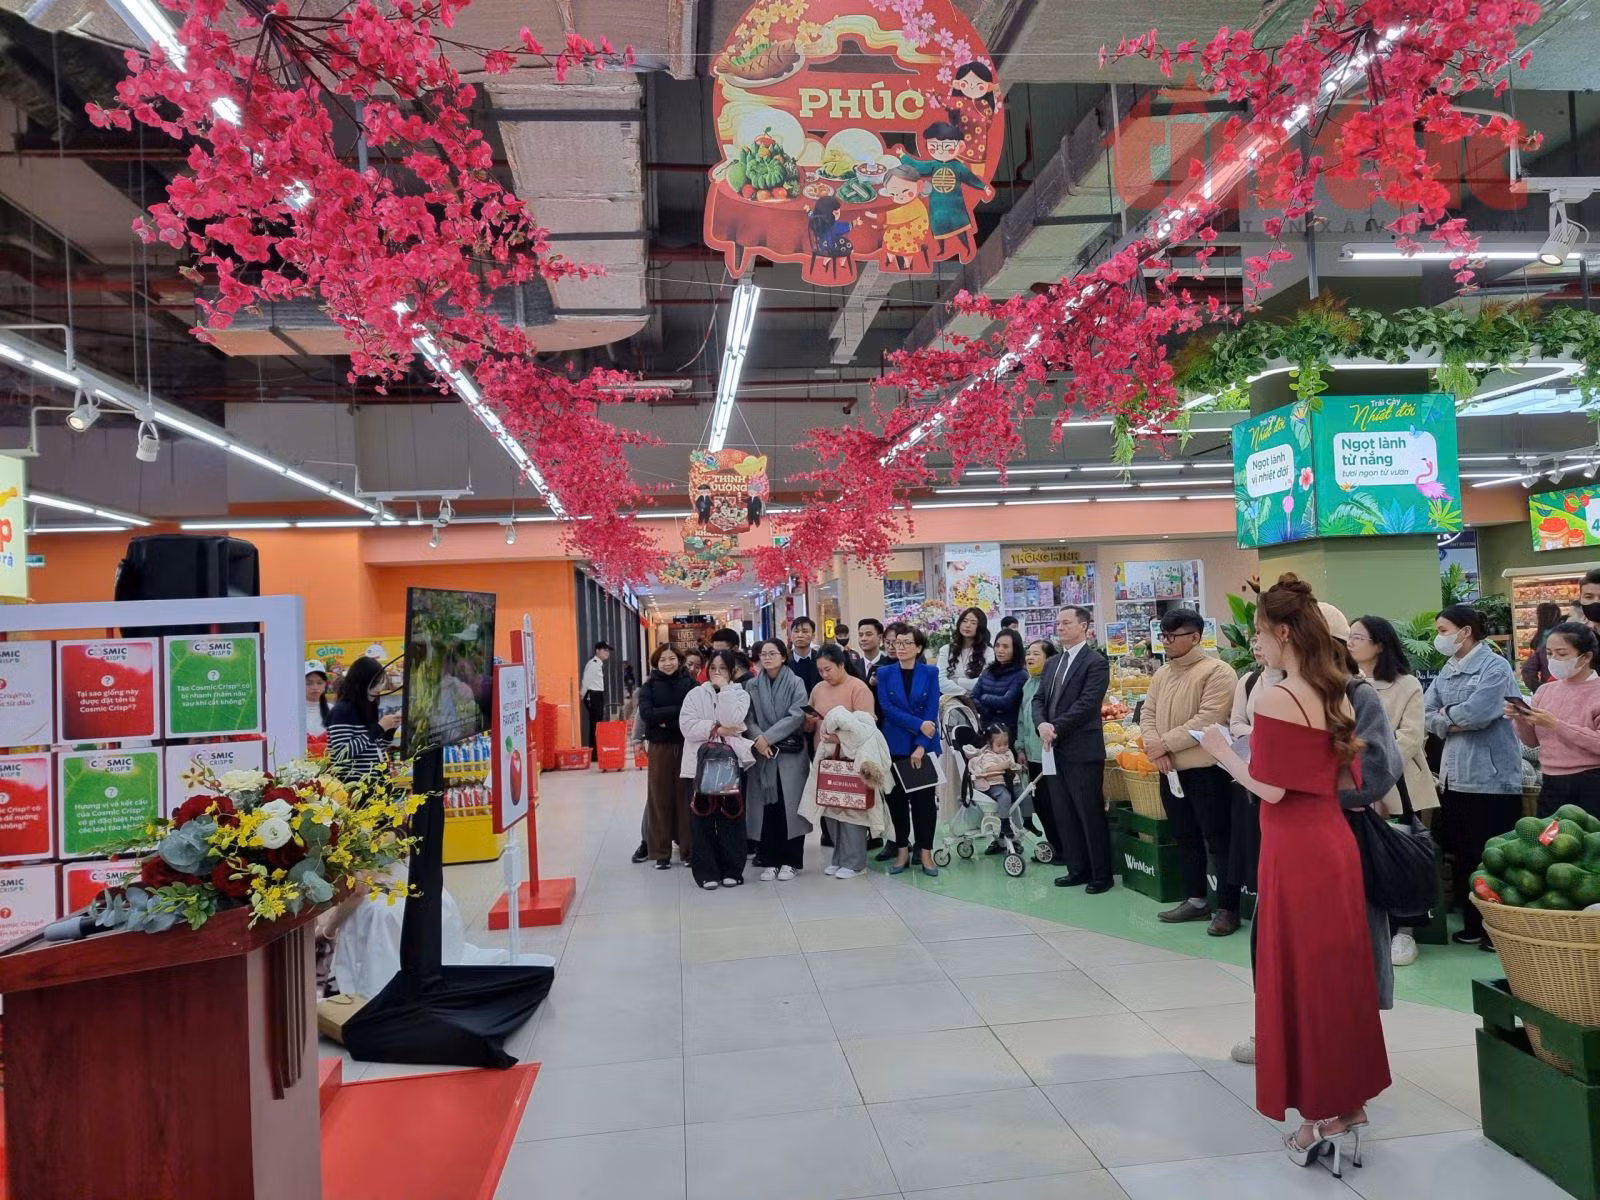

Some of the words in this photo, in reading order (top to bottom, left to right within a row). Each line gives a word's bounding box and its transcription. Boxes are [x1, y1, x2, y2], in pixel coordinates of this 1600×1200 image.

[798, 81, 925, 120] PHÚC
[1341, 439, 1375, 453] Ngọt
[1378, 437, 1406, 450] lành
[1252, 456, 1269, 472] Ngọt
[1269, 452, 1285, 466] lành
[1342, 453, 1357, 467] từ
[1359, 452, 1392, 469] nắng
[1257, 469, 1275, 485] nhiệt
[194, 643, 232, 651] COSMIC
[77, 691, 88, 699] Tại
[103, 688, 124, 698] giống
[126, 689, 139, 697] này
[191, 684, 216, 692] Cosmic
[80, 698, 99, 706] được
[101, 697, 113, 705] đặt
[80, 705, 107, 714] Cosmic
[91, 758, 132, 767] COSMIC
[91, 809, 120, 818] Cosmic
[1124, 853, 1155, 877] WinMart
